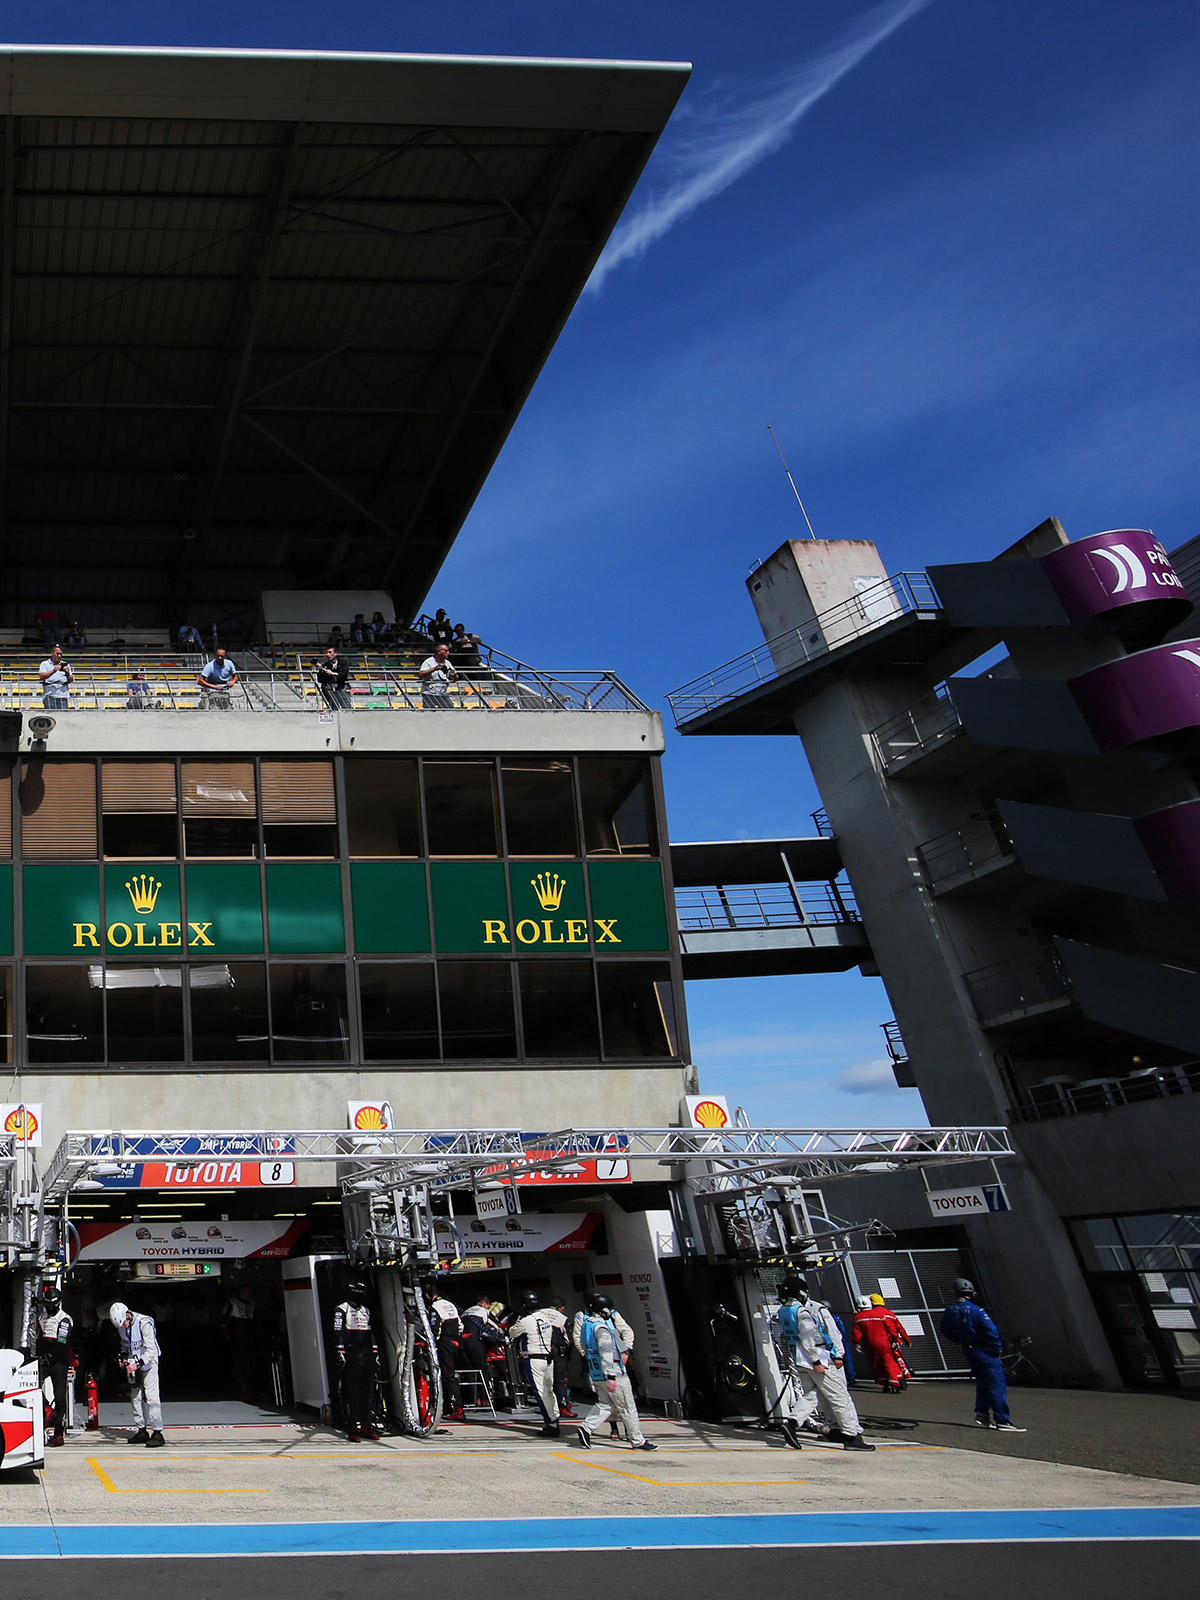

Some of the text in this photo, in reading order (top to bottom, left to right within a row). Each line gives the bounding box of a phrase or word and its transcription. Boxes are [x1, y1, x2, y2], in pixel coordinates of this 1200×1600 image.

[73, 923, 214, 947] ROLEX
[482, 919, 621, 943] ROLEX
[164, 1162, 241, 1183] TOYOTA
[271, 1163, 282, 1181] 8
[477, 1189, 516, 1214] TOYOTA 8
[933, 1187, 999, 1210] TOYOTA 7
[142, 1247, 225, 1256] TOYOTA HYBRID
[482, 1241, 524, 1249] HYBRID
[156, 1265, 163, 1274] 8
[196, 1265, 202, 1274] 8
[630, 1274, 651, 1283] DENSO
